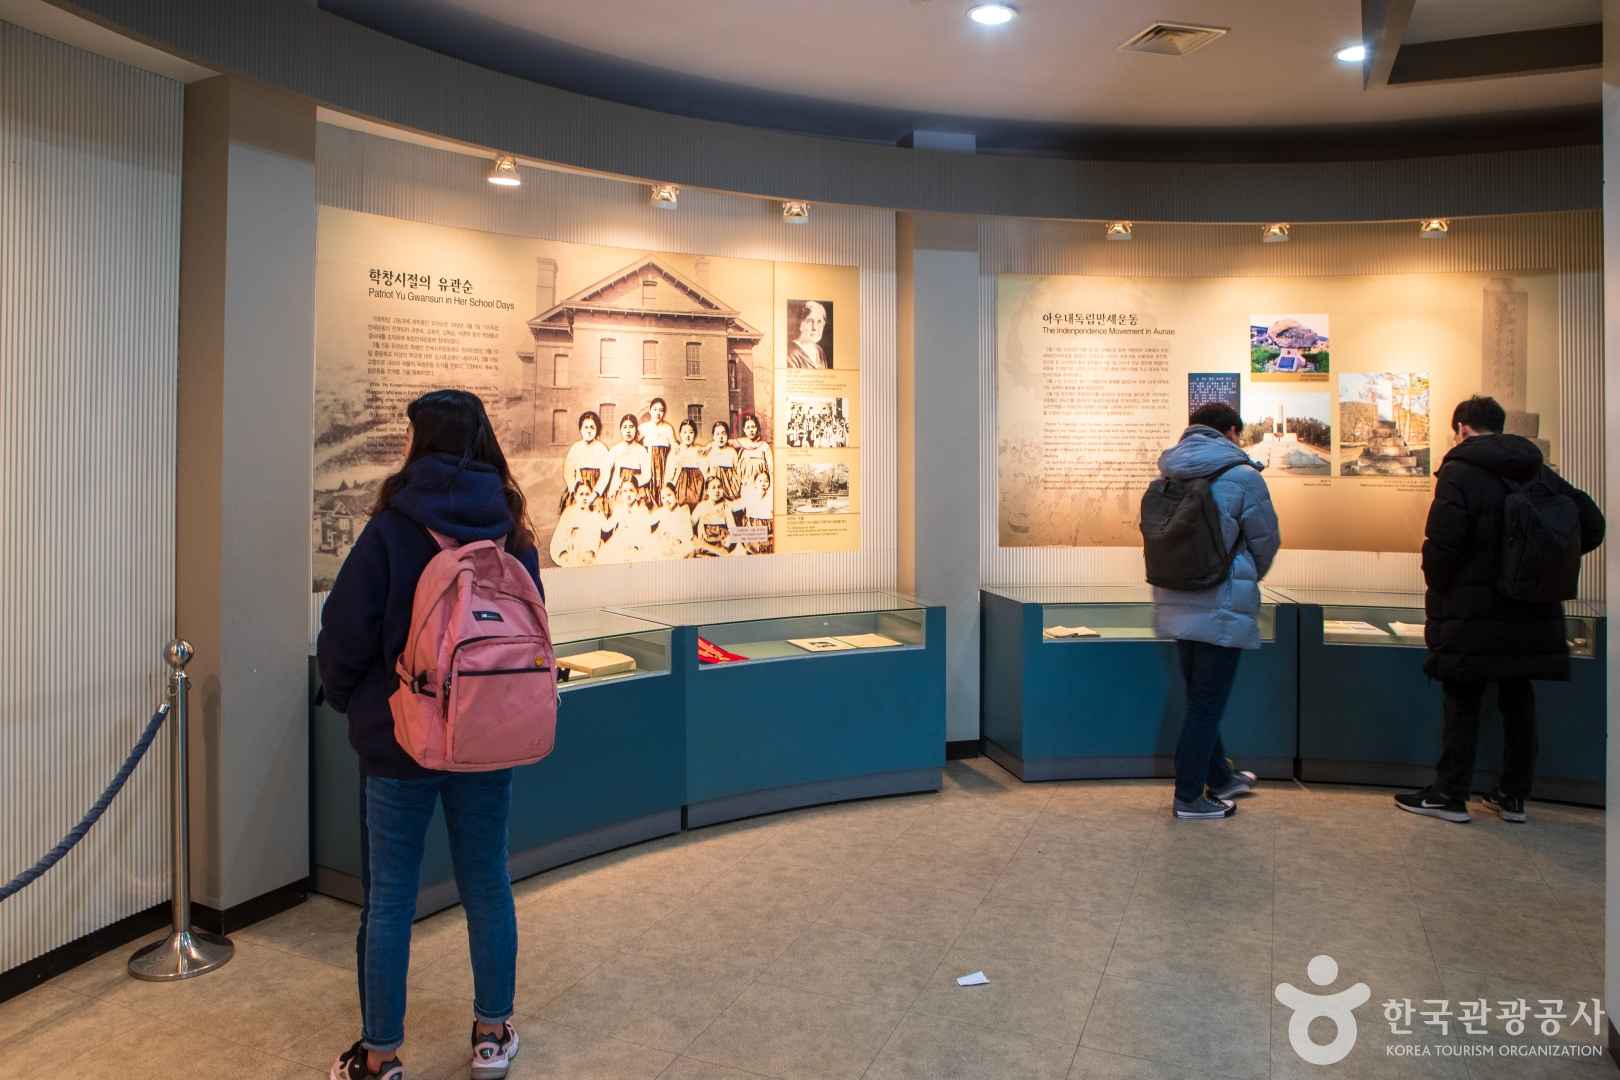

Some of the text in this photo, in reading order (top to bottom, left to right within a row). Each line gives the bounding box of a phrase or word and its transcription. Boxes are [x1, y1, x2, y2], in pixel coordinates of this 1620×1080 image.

[369, 268, 473, 295] 학창시절의 유관순
[368, 288, 515, 312] Patriot Yu Gwansun in Her School Days
[1042, 312, 1138, 326] 아우내독립만세운동
[1042, 327, 1056, 335] The
[1108, 327, 1145, 335] Movement
